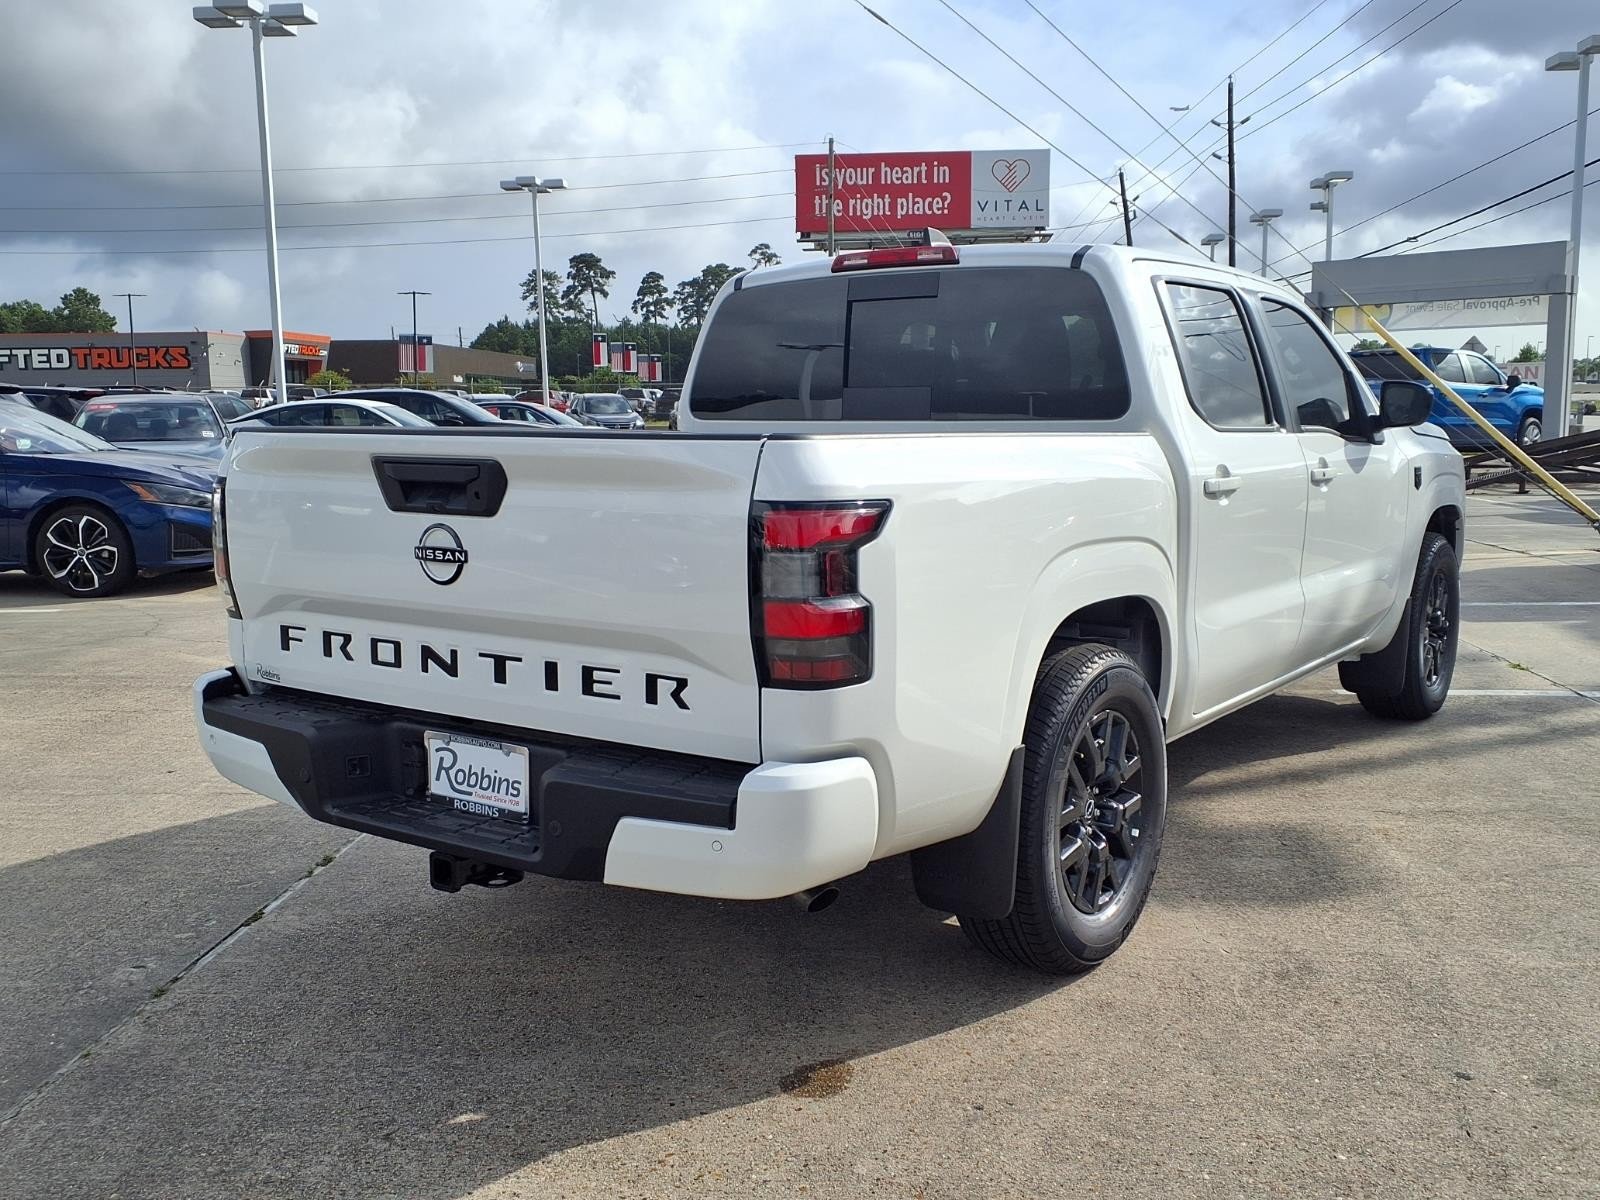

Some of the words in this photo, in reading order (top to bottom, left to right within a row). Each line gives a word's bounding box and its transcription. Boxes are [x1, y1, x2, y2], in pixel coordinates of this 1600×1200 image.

[834, 166, 875, 190] your
[880, 162, 928, 184] heart
[933, 161, 950, 184] in
[815, 194, 843, 217] the
[848, 193, 891, 219] right
[897, 191, 952, 219] place?
[977, 199, 1044, 213] VITAL
[414, 548, 466, 562] NISSAN
[279, 624, 691, 710] FRONTIER
[434, 746, 522, 798] Robbins
[454, 799, 499, 817] ROBBINS
[474, 791, 493, 801] Trusted
[494, 795, 508, 805] Since
